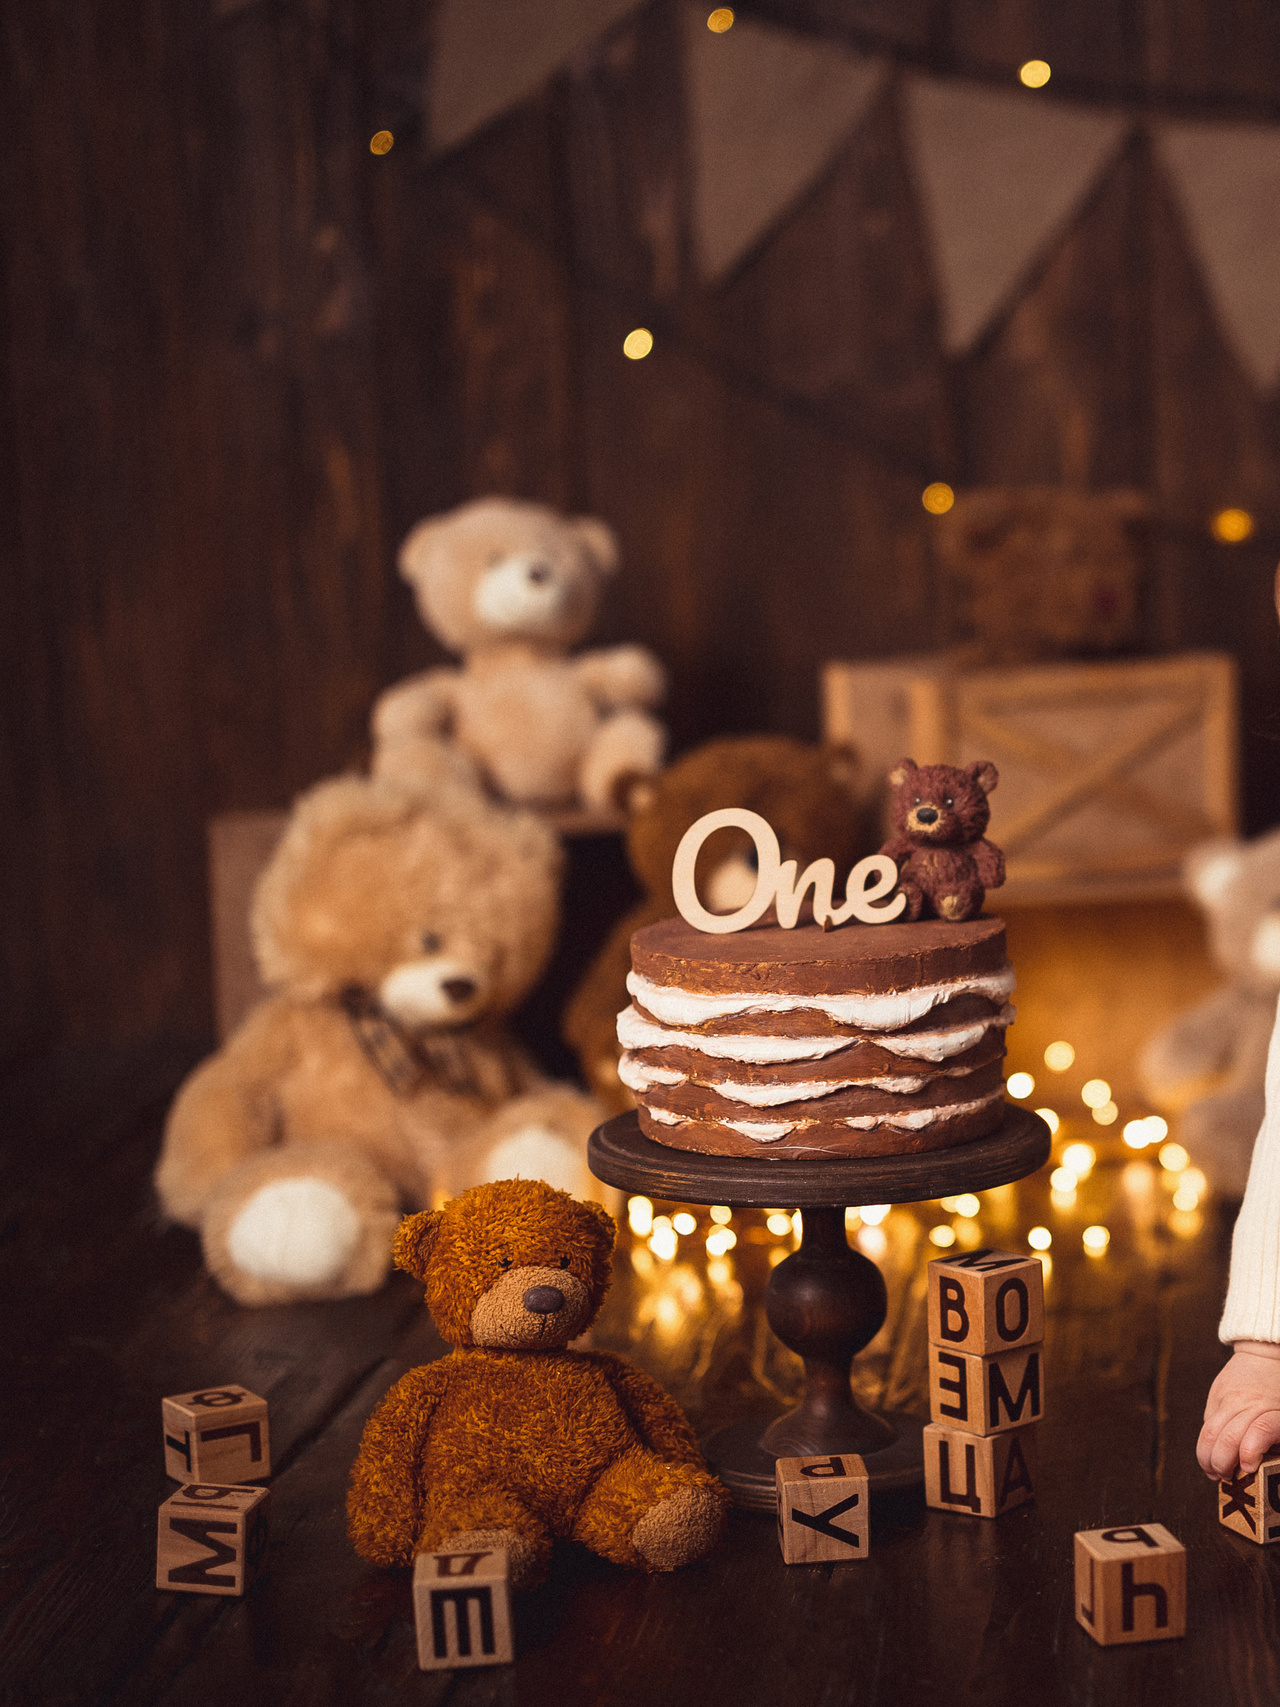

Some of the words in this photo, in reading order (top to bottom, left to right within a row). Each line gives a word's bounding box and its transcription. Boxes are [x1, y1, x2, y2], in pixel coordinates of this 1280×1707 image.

[672, 808, 906, 934] One
[939, 1275, 970, 1343] В
[988, 1353, 1040, 1428] М
[939, 1440, 981, 1513] Ц
[1001, 1437, 1033, 1506] А
